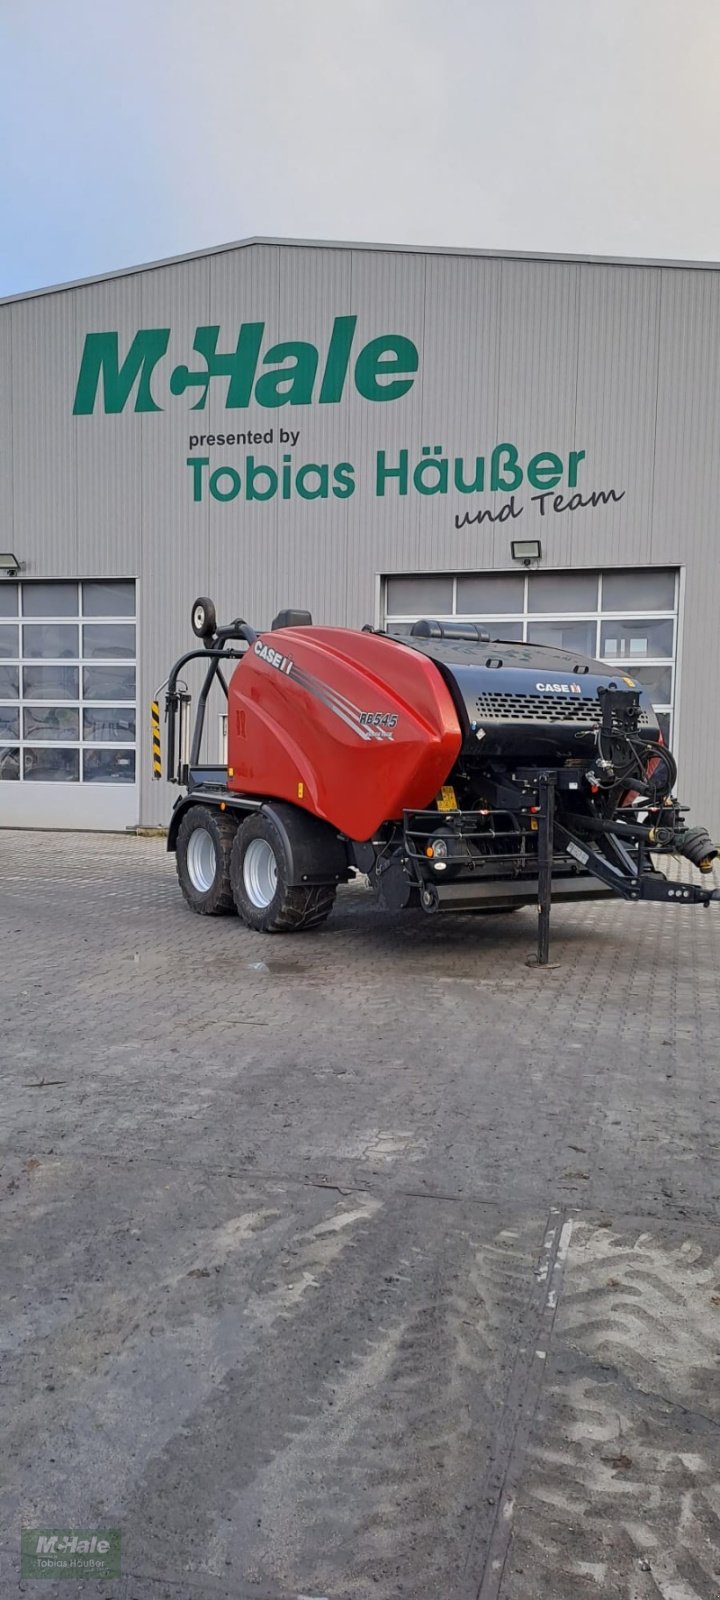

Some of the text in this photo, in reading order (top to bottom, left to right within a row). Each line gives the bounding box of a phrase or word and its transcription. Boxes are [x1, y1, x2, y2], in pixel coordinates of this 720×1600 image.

[72, 315, 419, 415] McHale
[188, 428, 300, 449] presented by
[186, 442, 586, 502] Tobias Häußer
[454, 488, 626, 529] und Team
[254, 640, 283, 669] CASE
[535, 682, 570, 693] CASE
